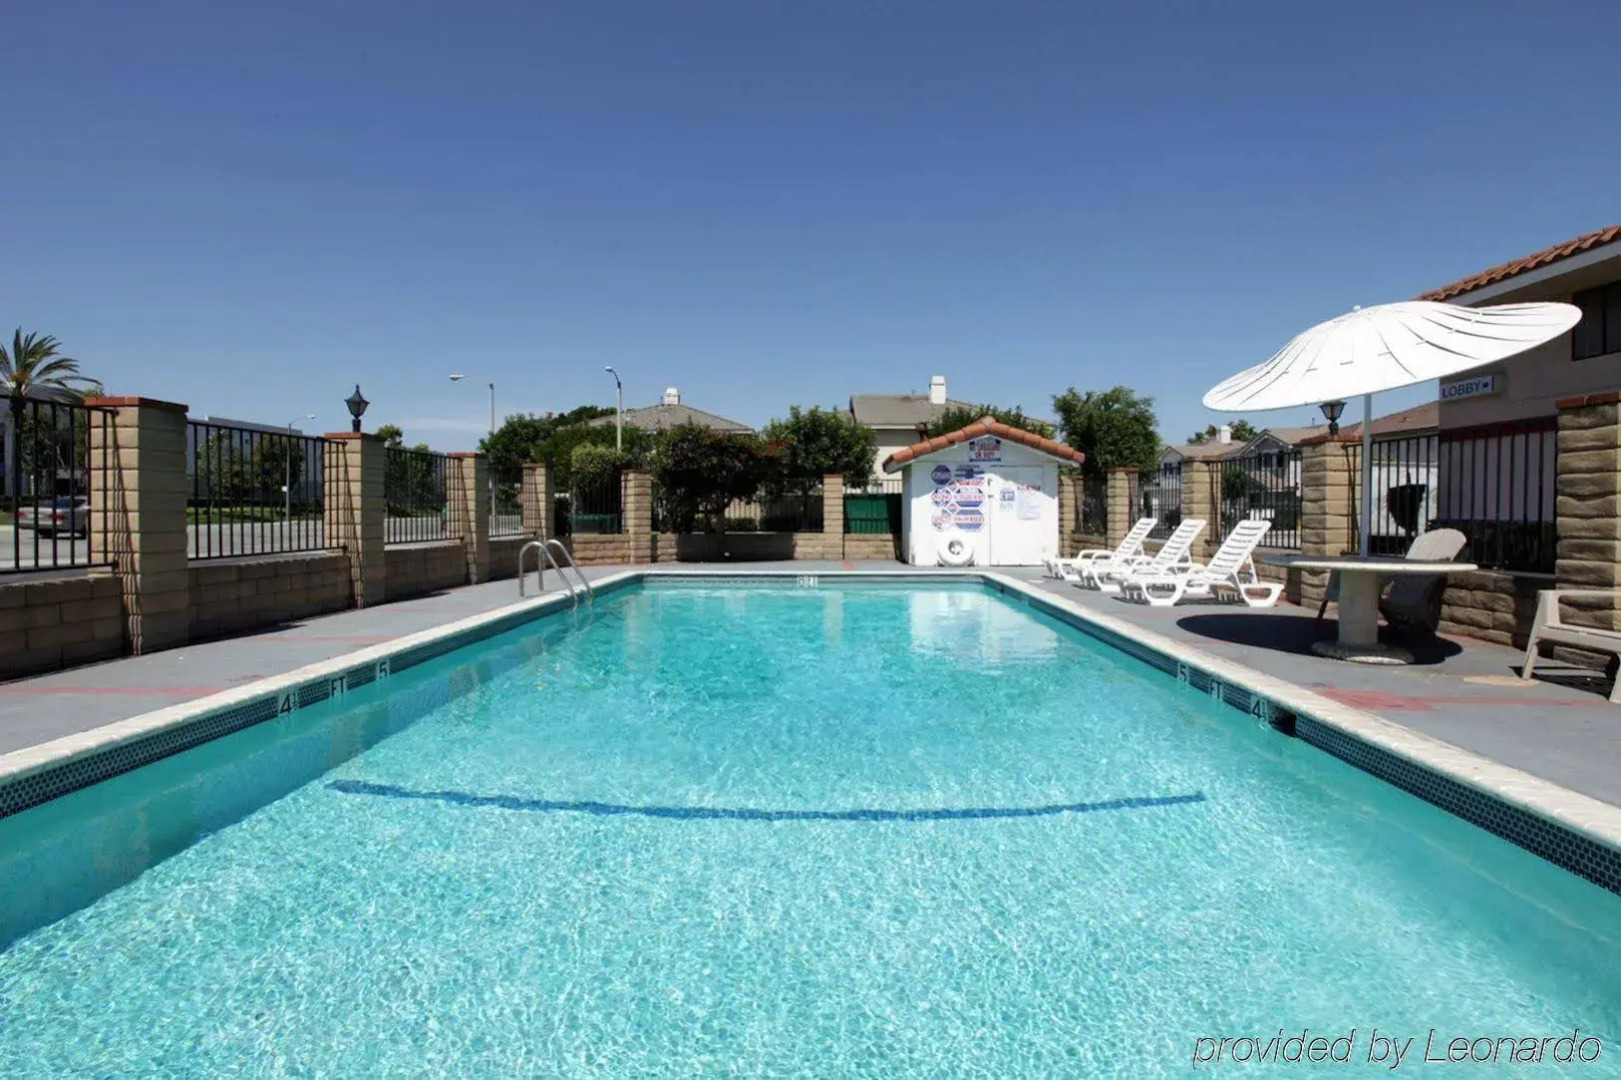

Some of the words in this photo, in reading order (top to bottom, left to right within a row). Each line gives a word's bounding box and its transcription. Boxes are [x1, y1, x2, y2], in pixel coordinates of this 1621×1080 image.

[1442, 380, 1481, 399] LOBBY
[331, 676, 346, 697] FT
[379, 661, 388, 680] 5
